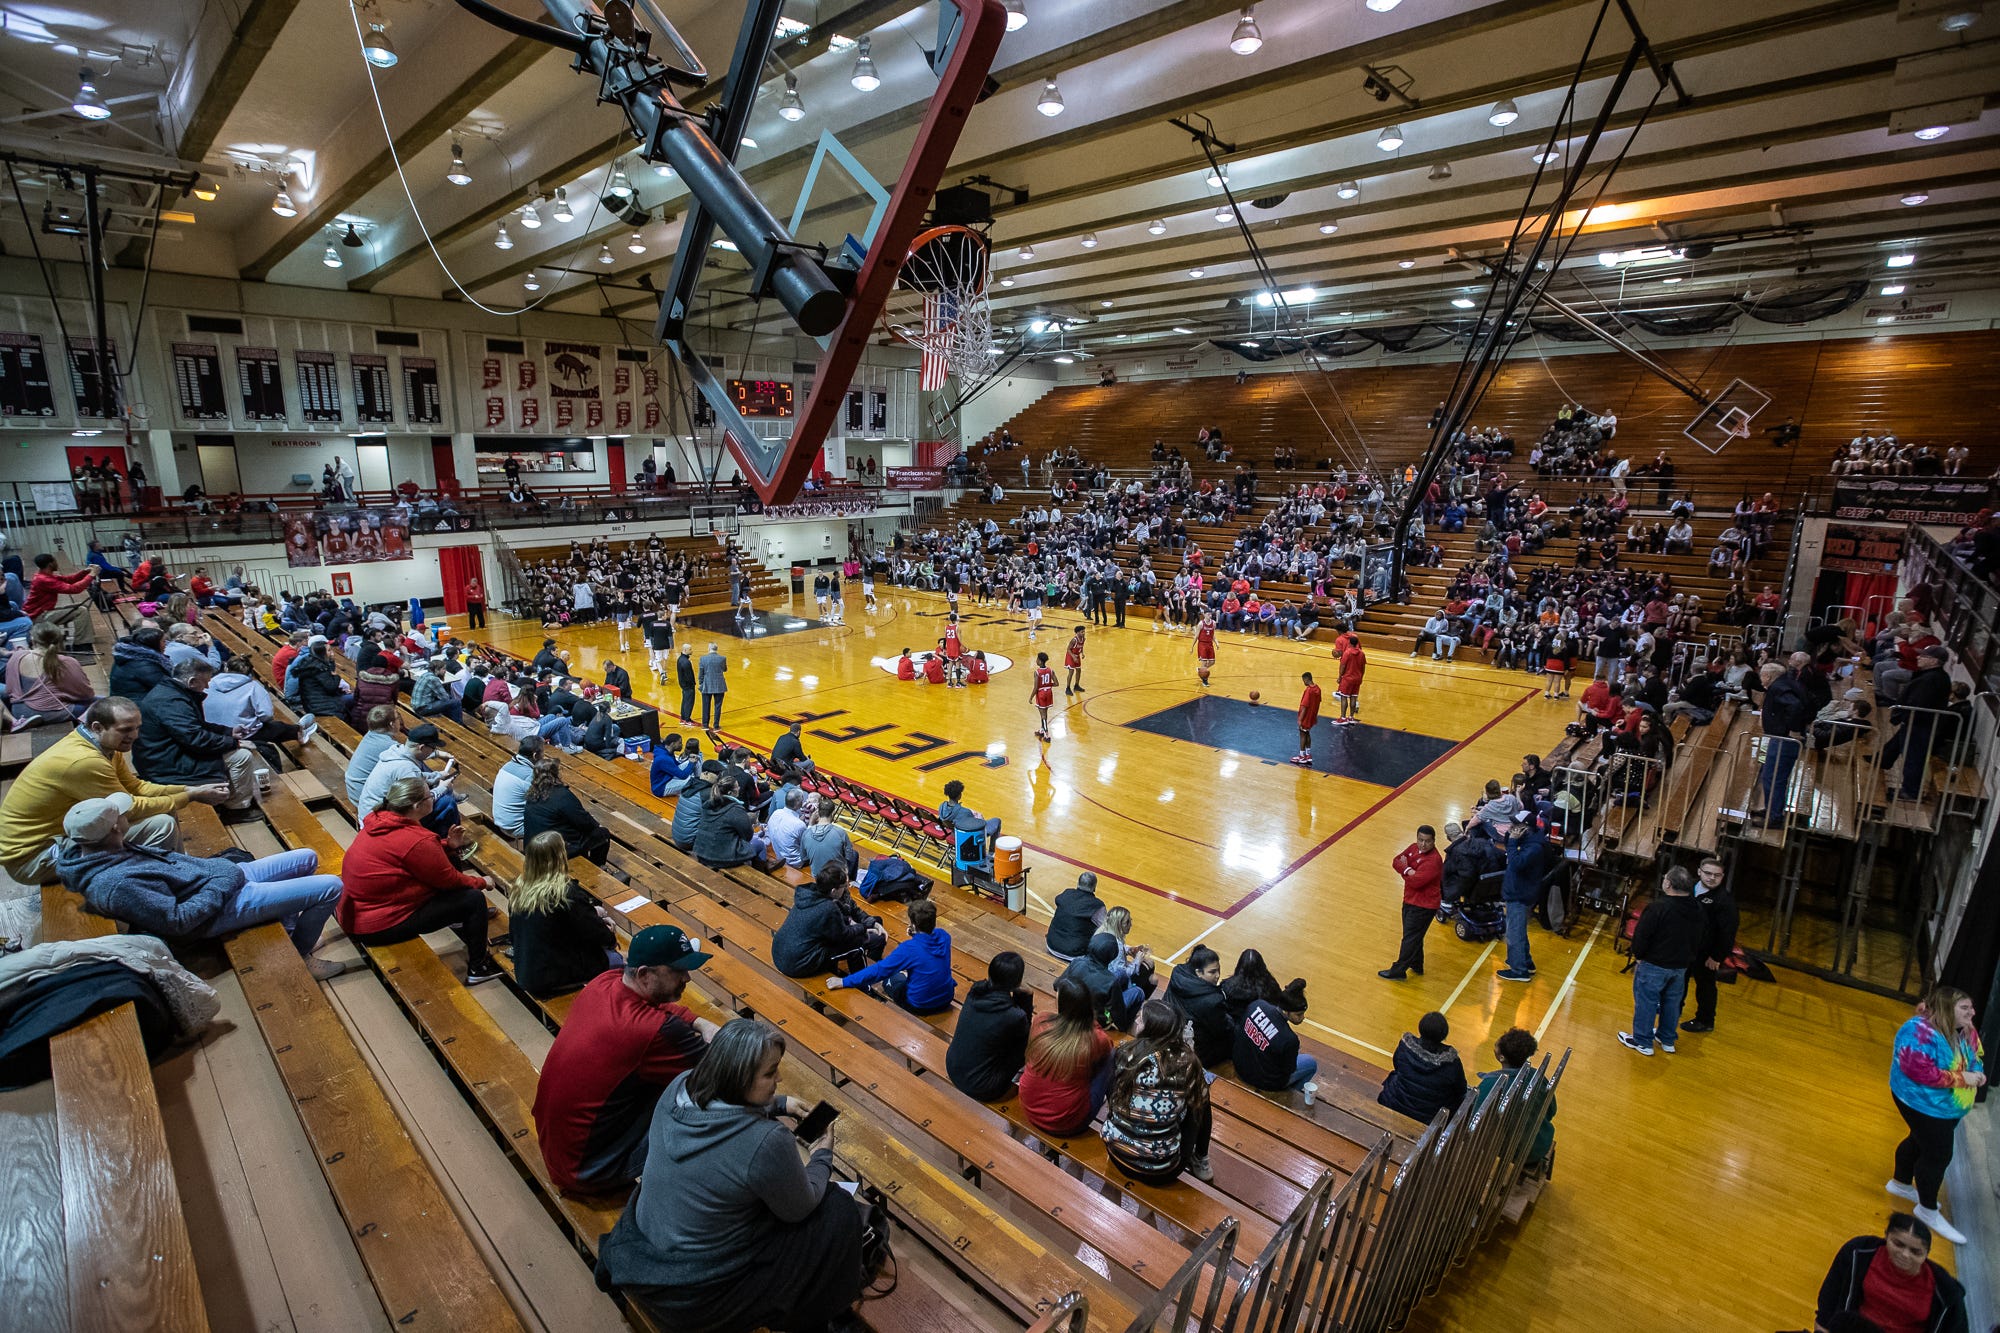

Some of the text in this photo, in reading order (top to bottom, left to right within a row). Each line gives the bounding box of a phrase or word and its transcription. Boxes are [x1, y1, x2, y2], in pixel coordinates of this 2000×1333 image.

[739, 387, 746, 400] 0
[755, 381, 776, 394] 3:22
[785, 389, 792, 402] 0
[741, 405, 747, 416] 0
[779, 406, 785, 416] 0
[271, 440, 322, 448] RESTROOMS
[1836, 506, 1874, 519] JEFF
[946, 629, 956, 639] 23
[979, 662, 985, 671] 2
[1041, 673, 1051, 685] 10
[761, 708, 1010, 772] JEFF
[1250, 1005, 1280, 1041] TEAM
[1000, 1105, 1009, 1113] 5
[921, 1118, 933, 1128] 5
[325, 1151, 346, 1165] 6
[985, 1160, 995, 1169] 4
[885, 1180, 904, 1195] 14
[1124, 1181, 1135, 1190] 3
[1051, 1206, 1063, 1216] 3
[355, 1222, 378, 1238] 5
[954, 1235, 973, 1251] 13
[1132, 1260, 1146, 1272] 2
